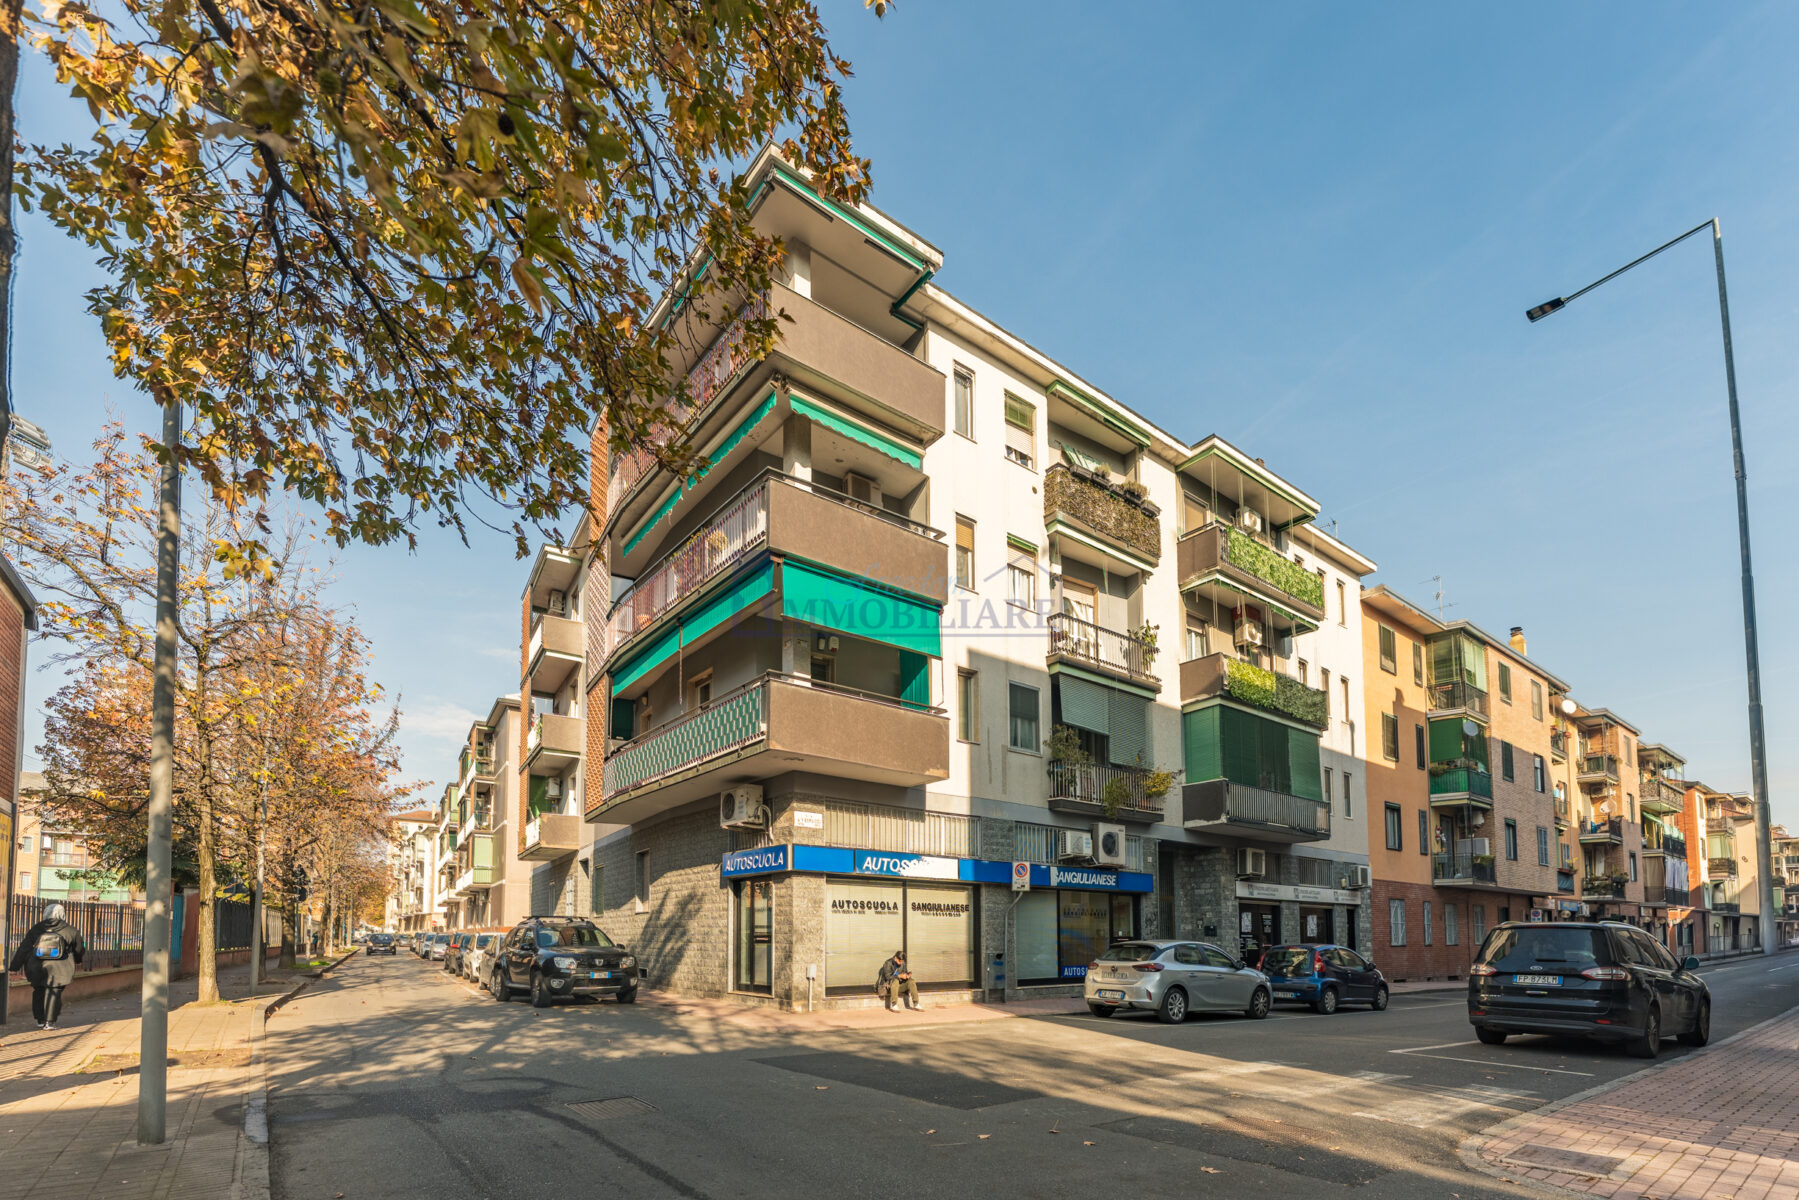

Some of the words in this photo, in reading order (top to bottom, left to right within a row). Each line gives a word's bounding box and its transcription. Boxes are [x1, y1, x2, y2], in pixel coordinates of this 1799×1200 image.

[725, 851, 784, 871] AUTOSCUOLA
[831, 899, 899, 911] AUTOSCUOLA
[911, 902, 970, 913] SANGIULIANESE
[1063, 966, 1088, 977] AUTOS
